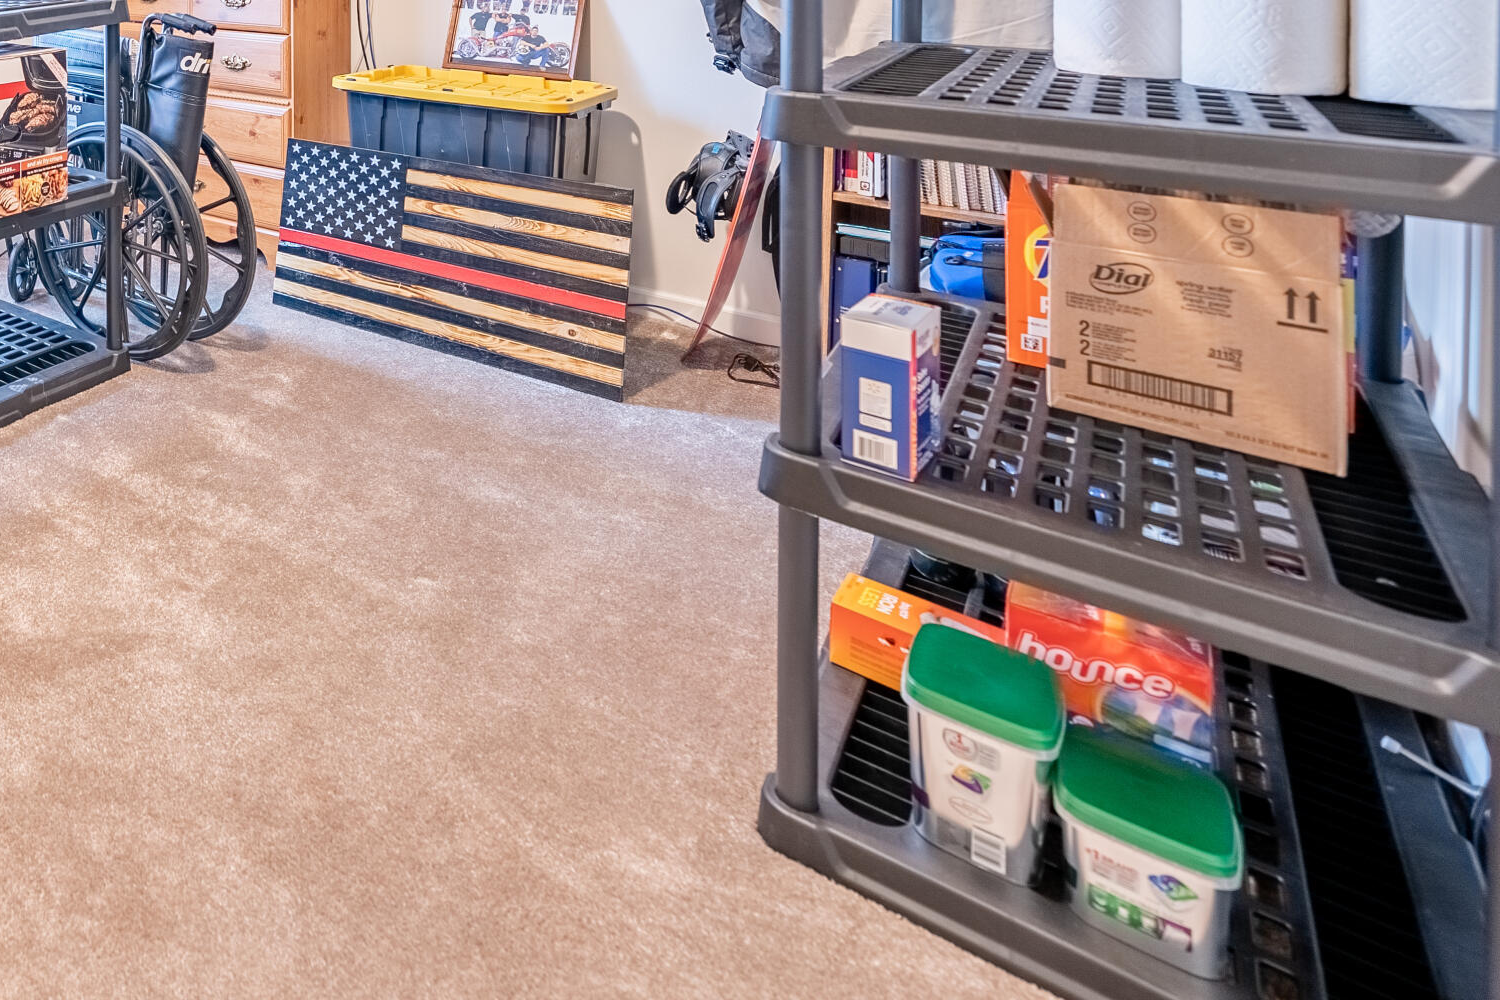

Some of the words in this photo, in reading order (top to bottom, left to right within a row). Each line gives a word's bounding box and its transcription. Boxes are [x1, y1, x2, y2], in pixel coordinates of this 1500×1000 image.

[180, 53, 211, 74] dri
[1093, 263, 1151, 288] Dial
[1079, 320, 1090, 337] 2
[1080, 339, 1090, 356] 2
[857, 584, 881, 609] LESS
[875, 591, 899, 616] IRON
[1014, 631, 1176, 698] bounce
